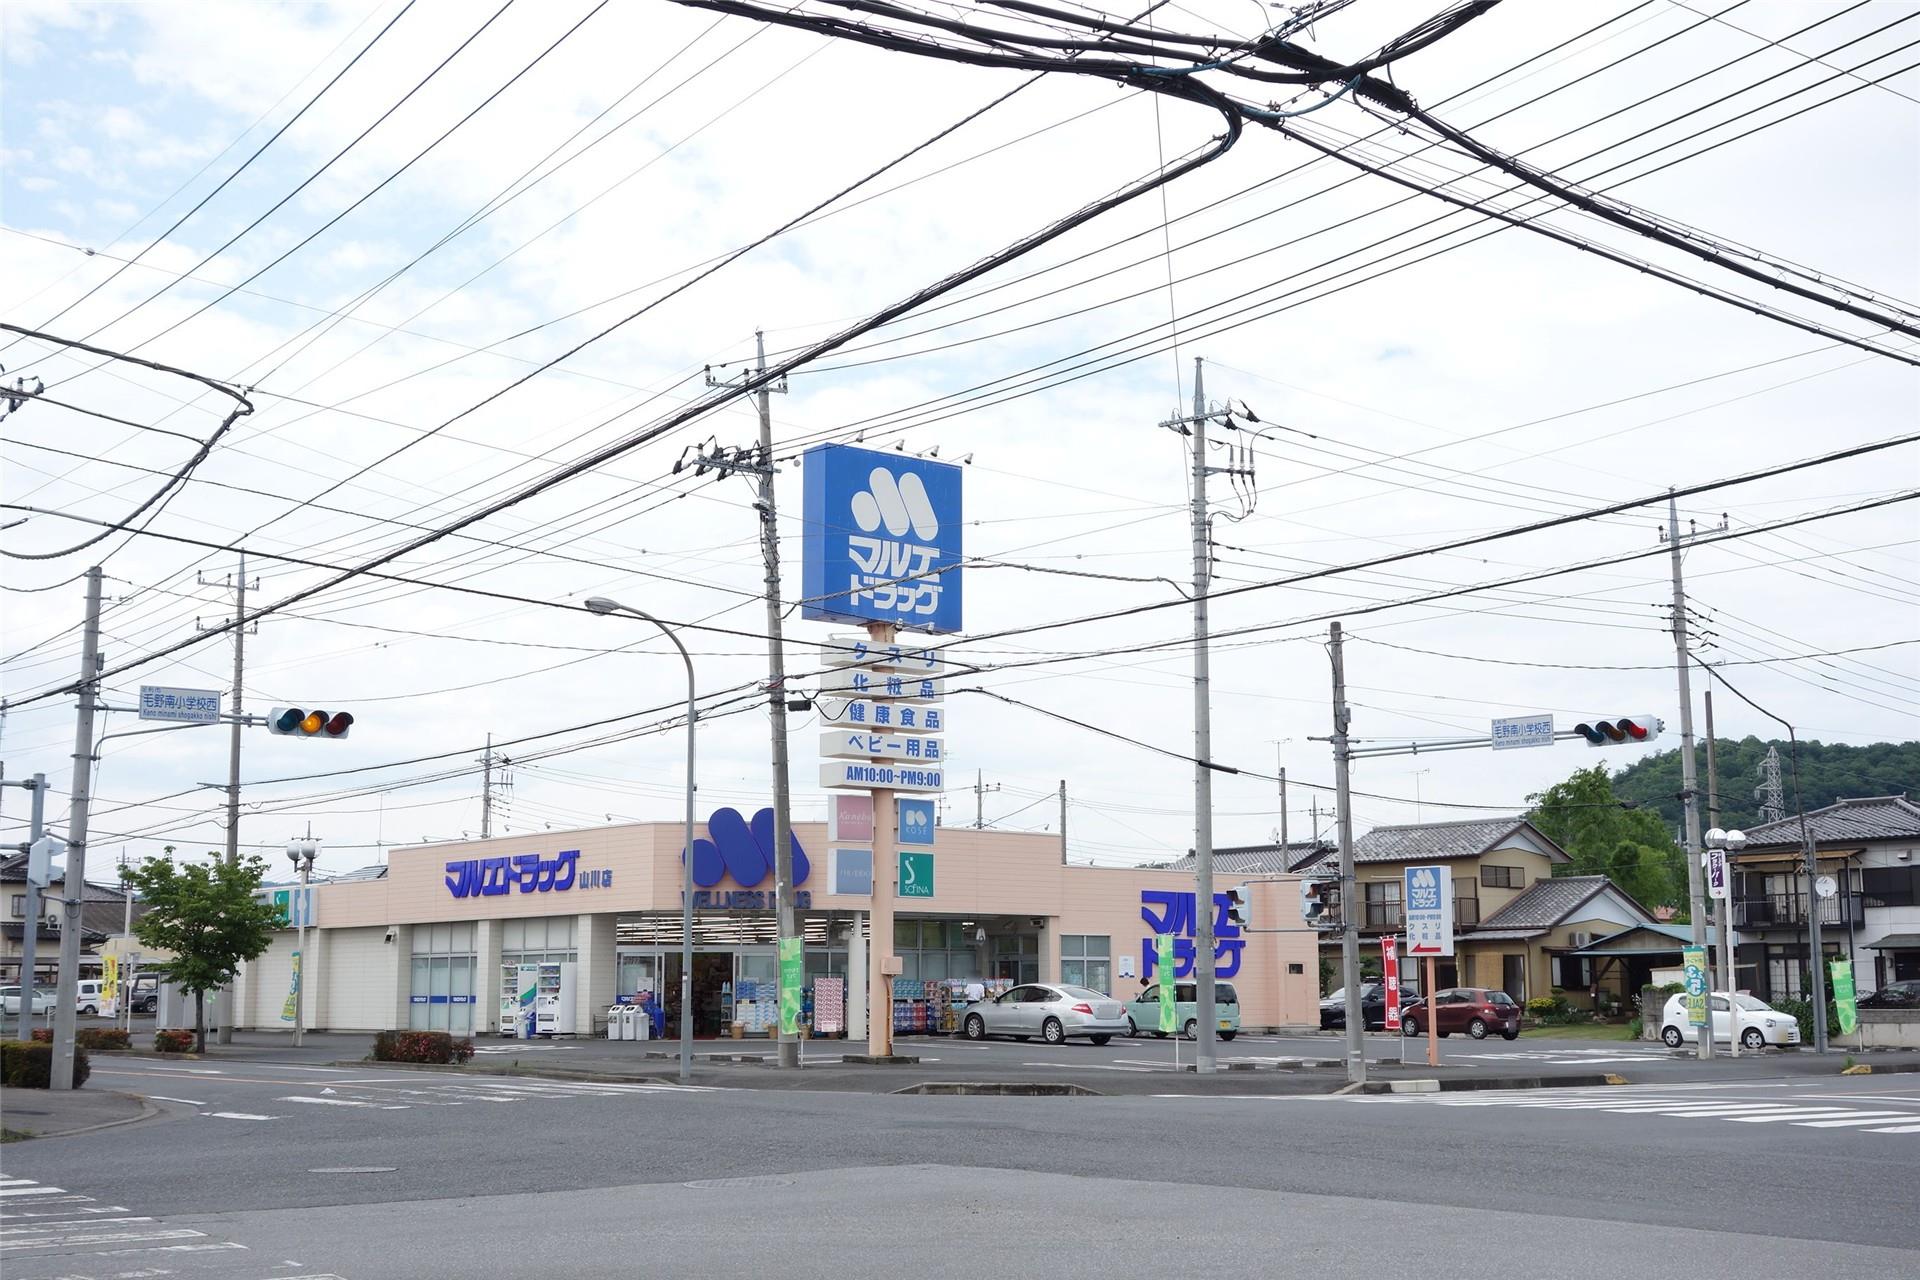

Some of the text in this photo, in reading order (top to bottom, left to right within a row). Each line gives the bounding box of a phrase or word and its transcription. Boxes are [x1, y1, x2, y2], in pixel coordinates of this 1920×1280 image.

[849, 535, 940, 583] マルエ
[850, 574, 943, 615] ドラッグ
[853, 673, 935, 699] 化粧品
[143, 693, 217, 712] 毛野南小学校西
[849, 703, 940, 729] 健康食品
[1494, 721, 1551, 739] 毛野南小学校西
[848, 735, 940, 759] ベビー用品
[445, 850, 613, 899] マルエドラッグ 山川店
[768, 890, 811, 909] DUG
[1411, 888, 1437, 898] マルエ
[1412, 898, 1437, 908] ドラッグ
[1409, 922, 1441, 930] クスリ
